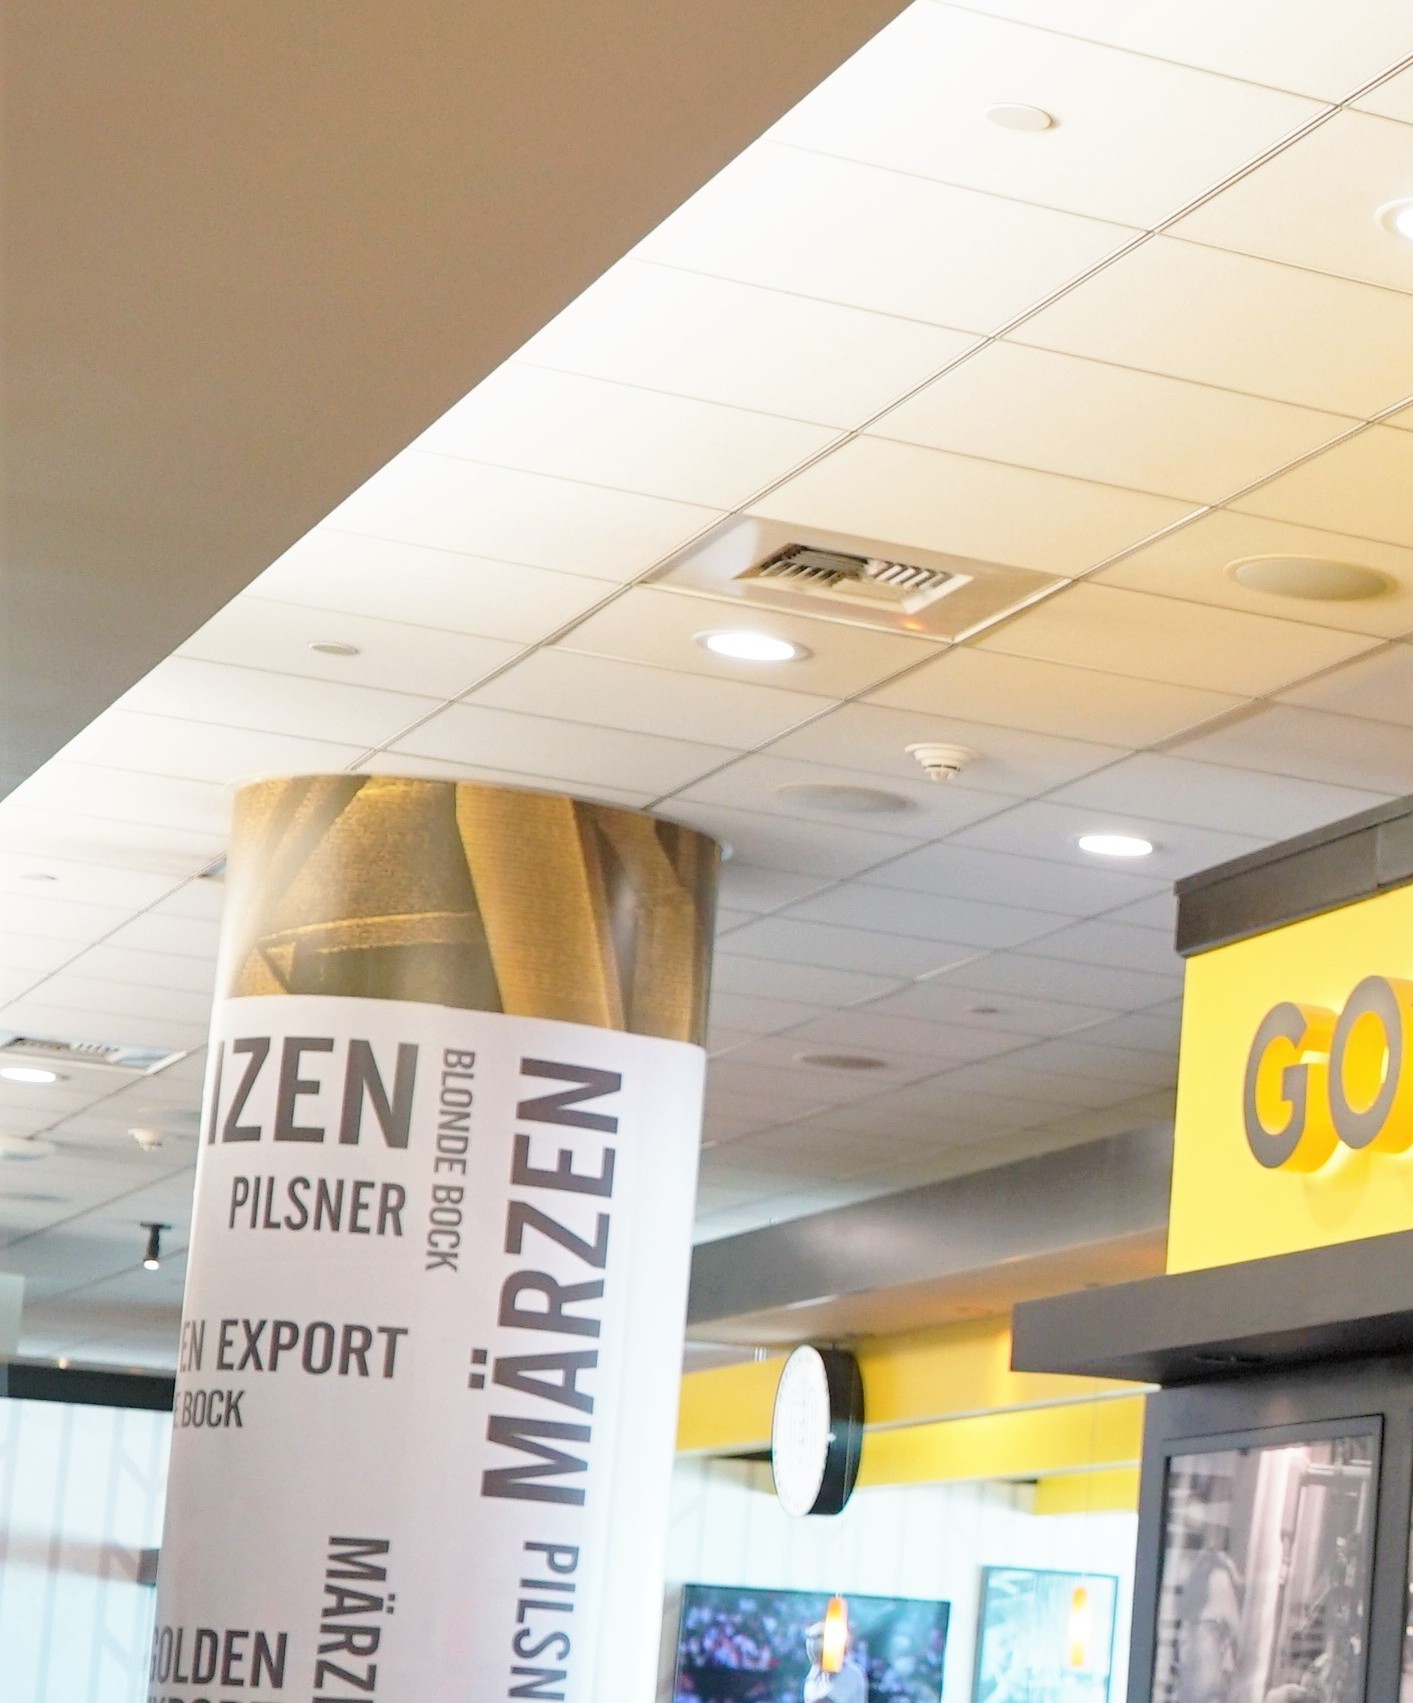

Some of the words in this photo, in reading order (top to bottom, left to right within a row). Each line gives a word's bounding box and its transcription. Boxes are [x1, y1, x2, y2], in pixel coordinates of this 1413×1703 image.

[433, 1047, 477, 1177] BLONDE
[228, 1175, 407, 1237] PILSNER
[424, 1183, 465, 1273] BOCK
[468, 1056, 623, 1508] MÄRZEN
[216, 1318, 409, 1380] EXPORT
[181, 1388, 245, 1429] BOCK
[311, 1536, 397, 1703] MÄRZ
[507, 1540, 580, 1703] PILSN
